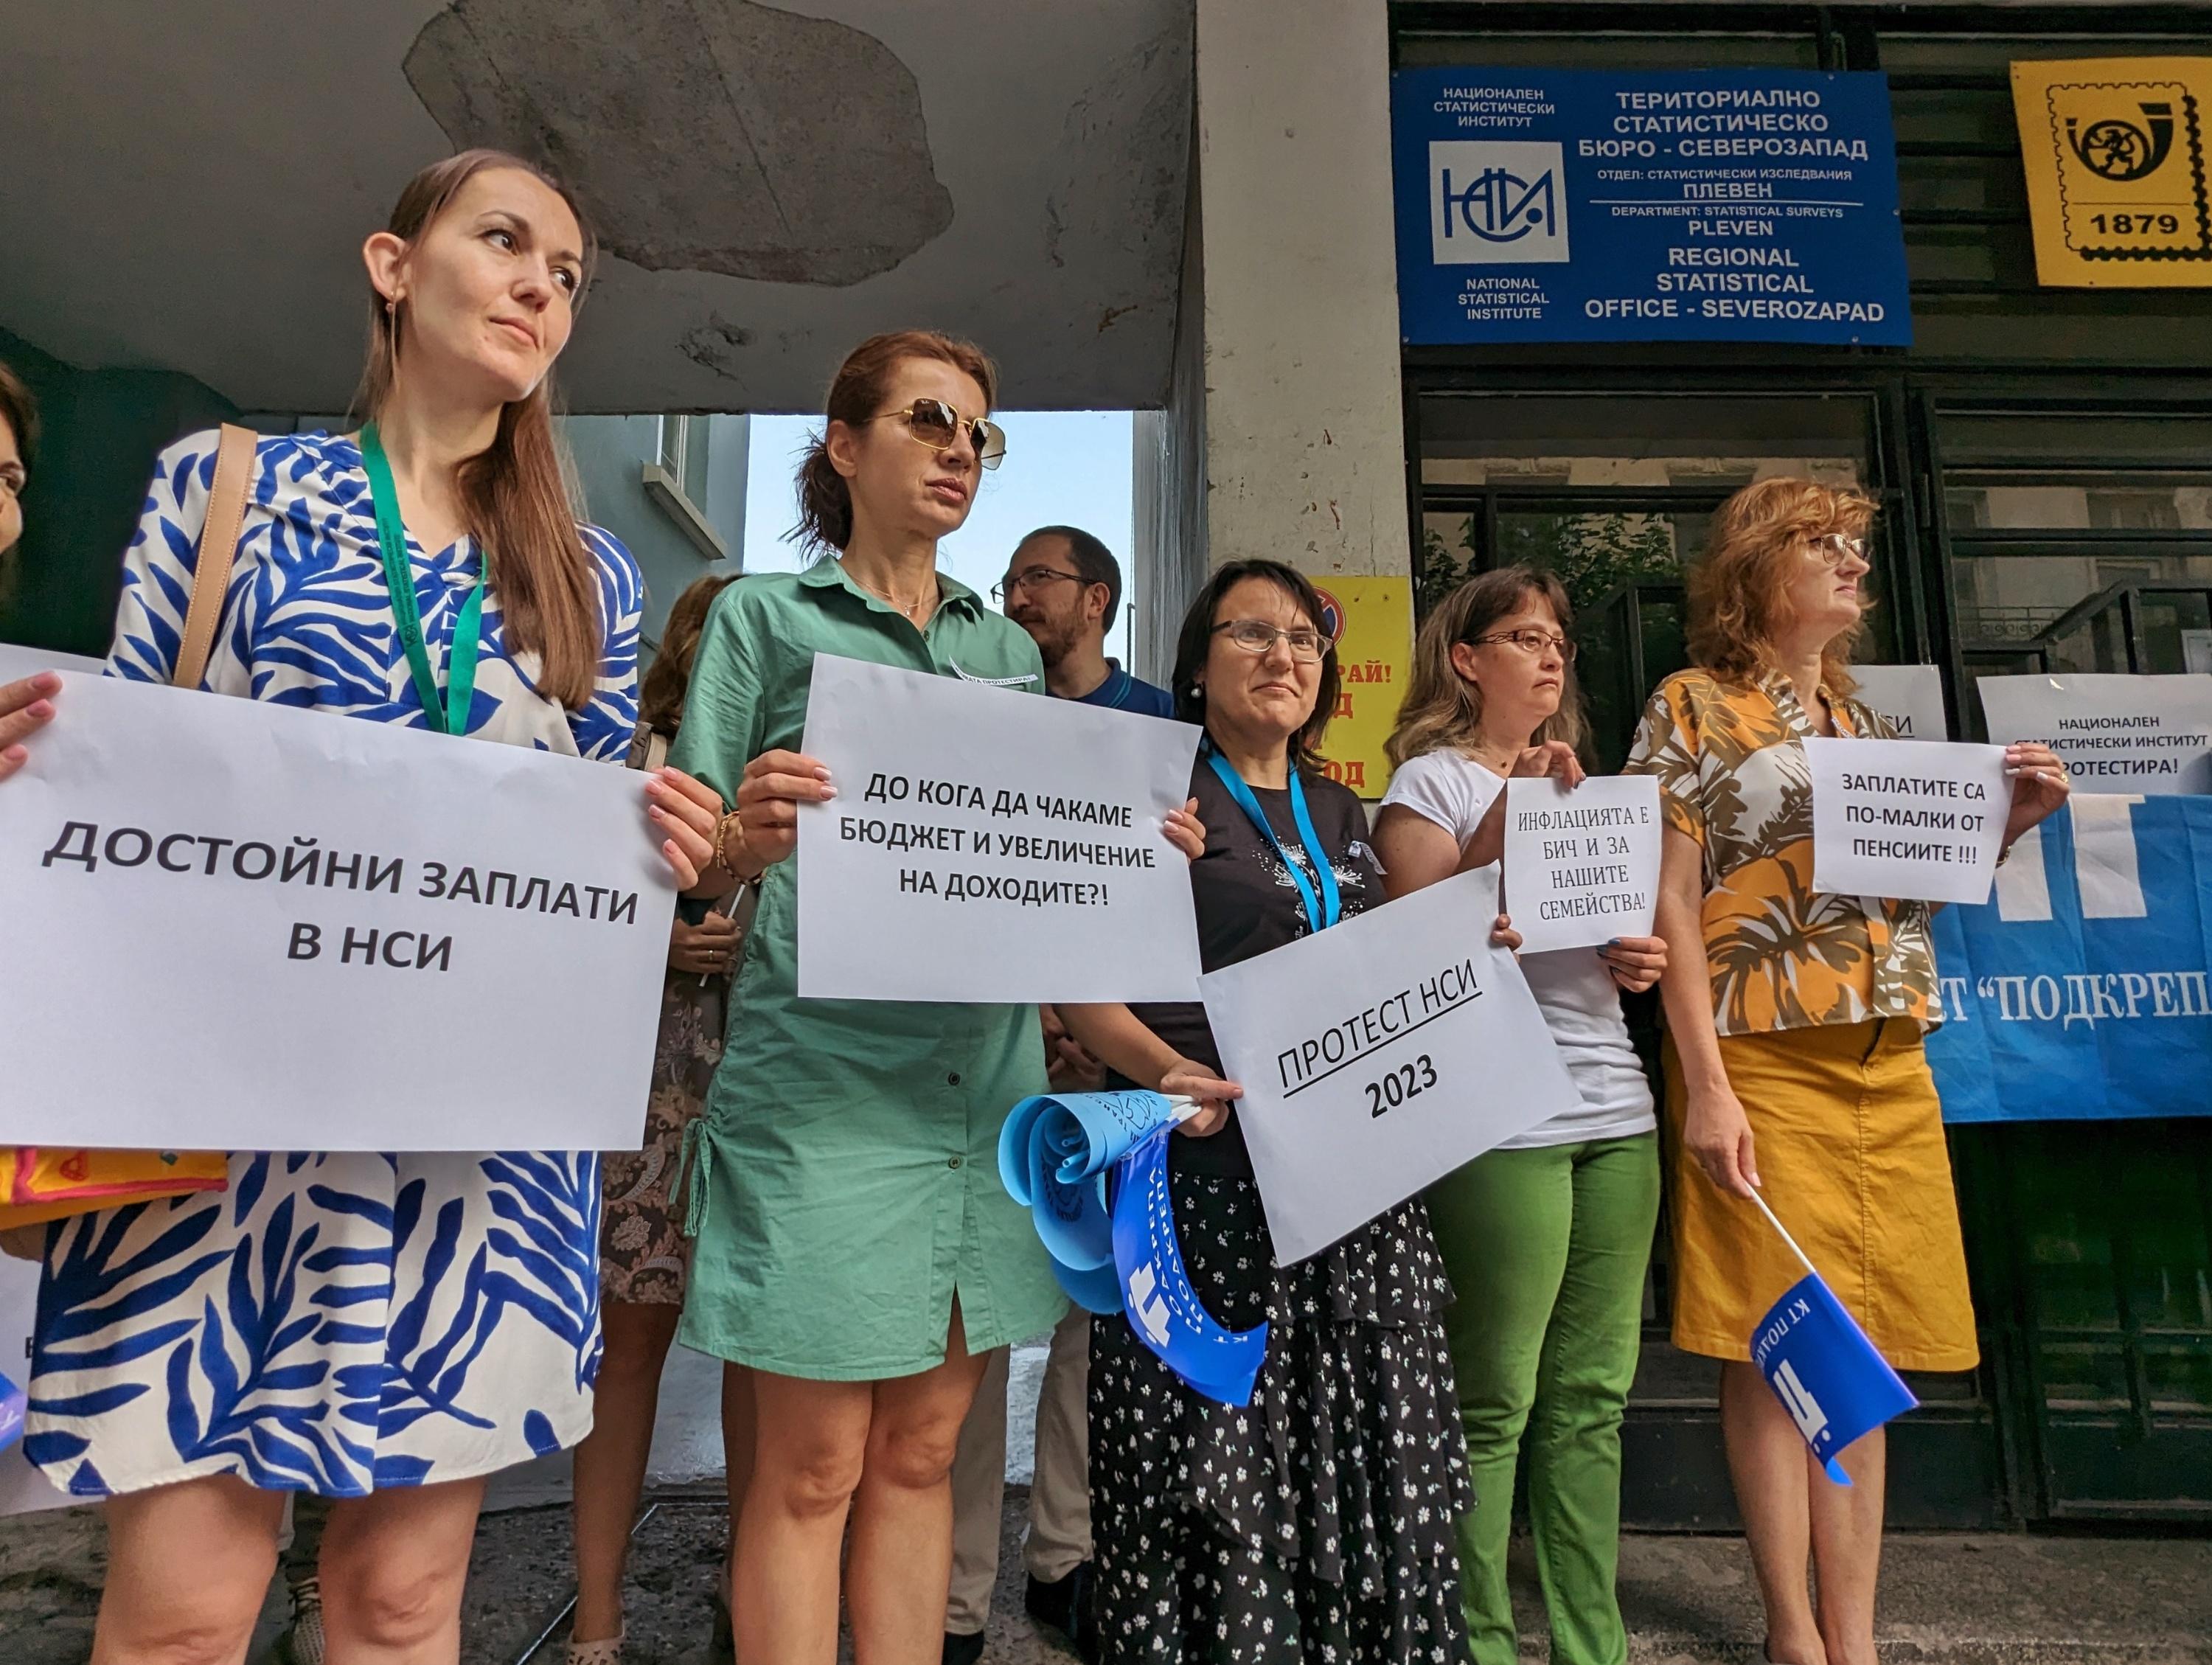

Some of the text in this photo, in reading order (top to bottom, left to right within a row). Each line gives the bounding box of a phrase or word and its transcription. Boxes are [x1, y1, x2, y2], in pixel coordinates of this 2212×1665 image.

[1444, 88, 1544, 100] НАЦИОНАЛЕН
[1615, 90, 1821, 108] ТЕРИТОРИАЛНО
[1433, 102, 1555, 114] СТАТИСТИЧЕСКИ
[1458, 115, 1532, 127] ИНСТИТУТ
[1613, 114, 1829, 133] СТАТИСТИЧЕСКО
[1579, 139, 1655, 157] БЮРО
[1678, 139, 1868, 161] СЕВЕРОЗАПАД
[1597, 169, 1852, 181] ОТДЕЛ: СТАТИСТИЧЕСКИ ИЗСЛЕДВАНИЯ
[1683, 182, 1773, 198] ПЛЕВЕН
[1611, 206, 1843, 218] DEPARTMENT: STATISTICAL SURVEYS
[1688, 220, 1773, 236] PLEVEN
[2090, 214, 2179, 234] 1879
[1668, 248, 1800, 267] REGIONAL
[1466, 278, 1540, 291] NATIONAL
[1656, 273, 1814, 293] STATISTICAL
[1458, 293, 1550, 305] STATISTICAL
[1467, 307, 1542, 320] INSTITUTE
[1585, 299, 1678, 318] OFFICE
[1702, 300, 1885, 321] SEVEROZAPAD
[2059, 716, 2160, 731] НАЦИОНАЛЕН
[2135, 734, 2208, 748] ИНСТИТУТ
[1842, 773, 1986, 801] ЗАПЛАТИТЕ СА
[864, 773, 1133, 828] ДО КОГА ДА ЧАКАМЕ
[1517, 806, 1649, 832] ИНФЛАЦИЯТА Е
[1846, 805, 1985, 832] ПО-МАЛКИ ОТ
[840, 816, 1156, 869] БЮДЖЕТ И УВЕЛИЧЕНИЕ
[1543, 835, 1630, 860] БИЧ И ЗА
[1853, 838, 1978, 865] ПЕНСИИТЕ !!!
[41, 820, 639, 925] ДОСТОЙНИ ЗАПЛАТИ
[1551, 864, 1629, 889] НАШИТЕ
[899, 869, 1109, 907] НА ДОХОДИТЕ?!
[1540, 891, 1646, 920] СЕМЕЙСТВА!
[287, 922, 454, 973] В НСИ
[1277, 958, 1478, 1089] ПРОТЕСТ НСИ
[1364, 1054, 1439, 1119] 2023
[1787, 1299, 1811, 1324] КТ
